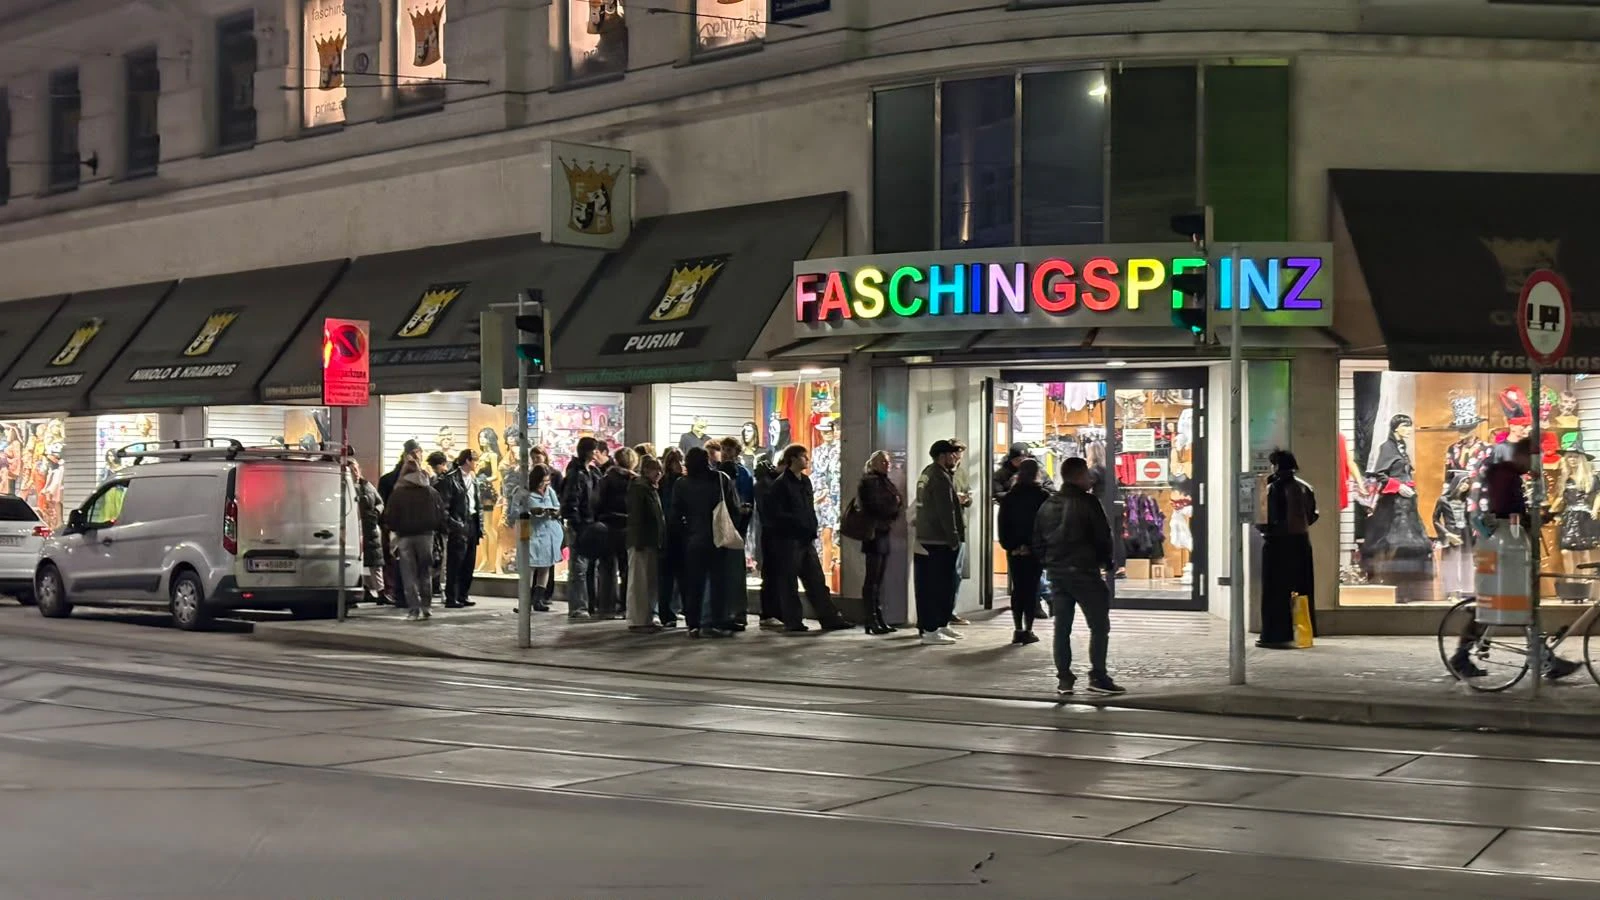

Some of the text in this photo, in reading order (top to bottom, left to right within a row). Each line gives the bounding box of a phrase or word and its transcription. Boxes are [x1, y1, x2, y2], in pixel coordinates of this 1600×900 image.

[624, 331, 684, 351] PURIM
[130, 364, 238, 381] NIKOLO & KRAMPUS
[13, 374, 83, 390] WEIHNACHTEN
